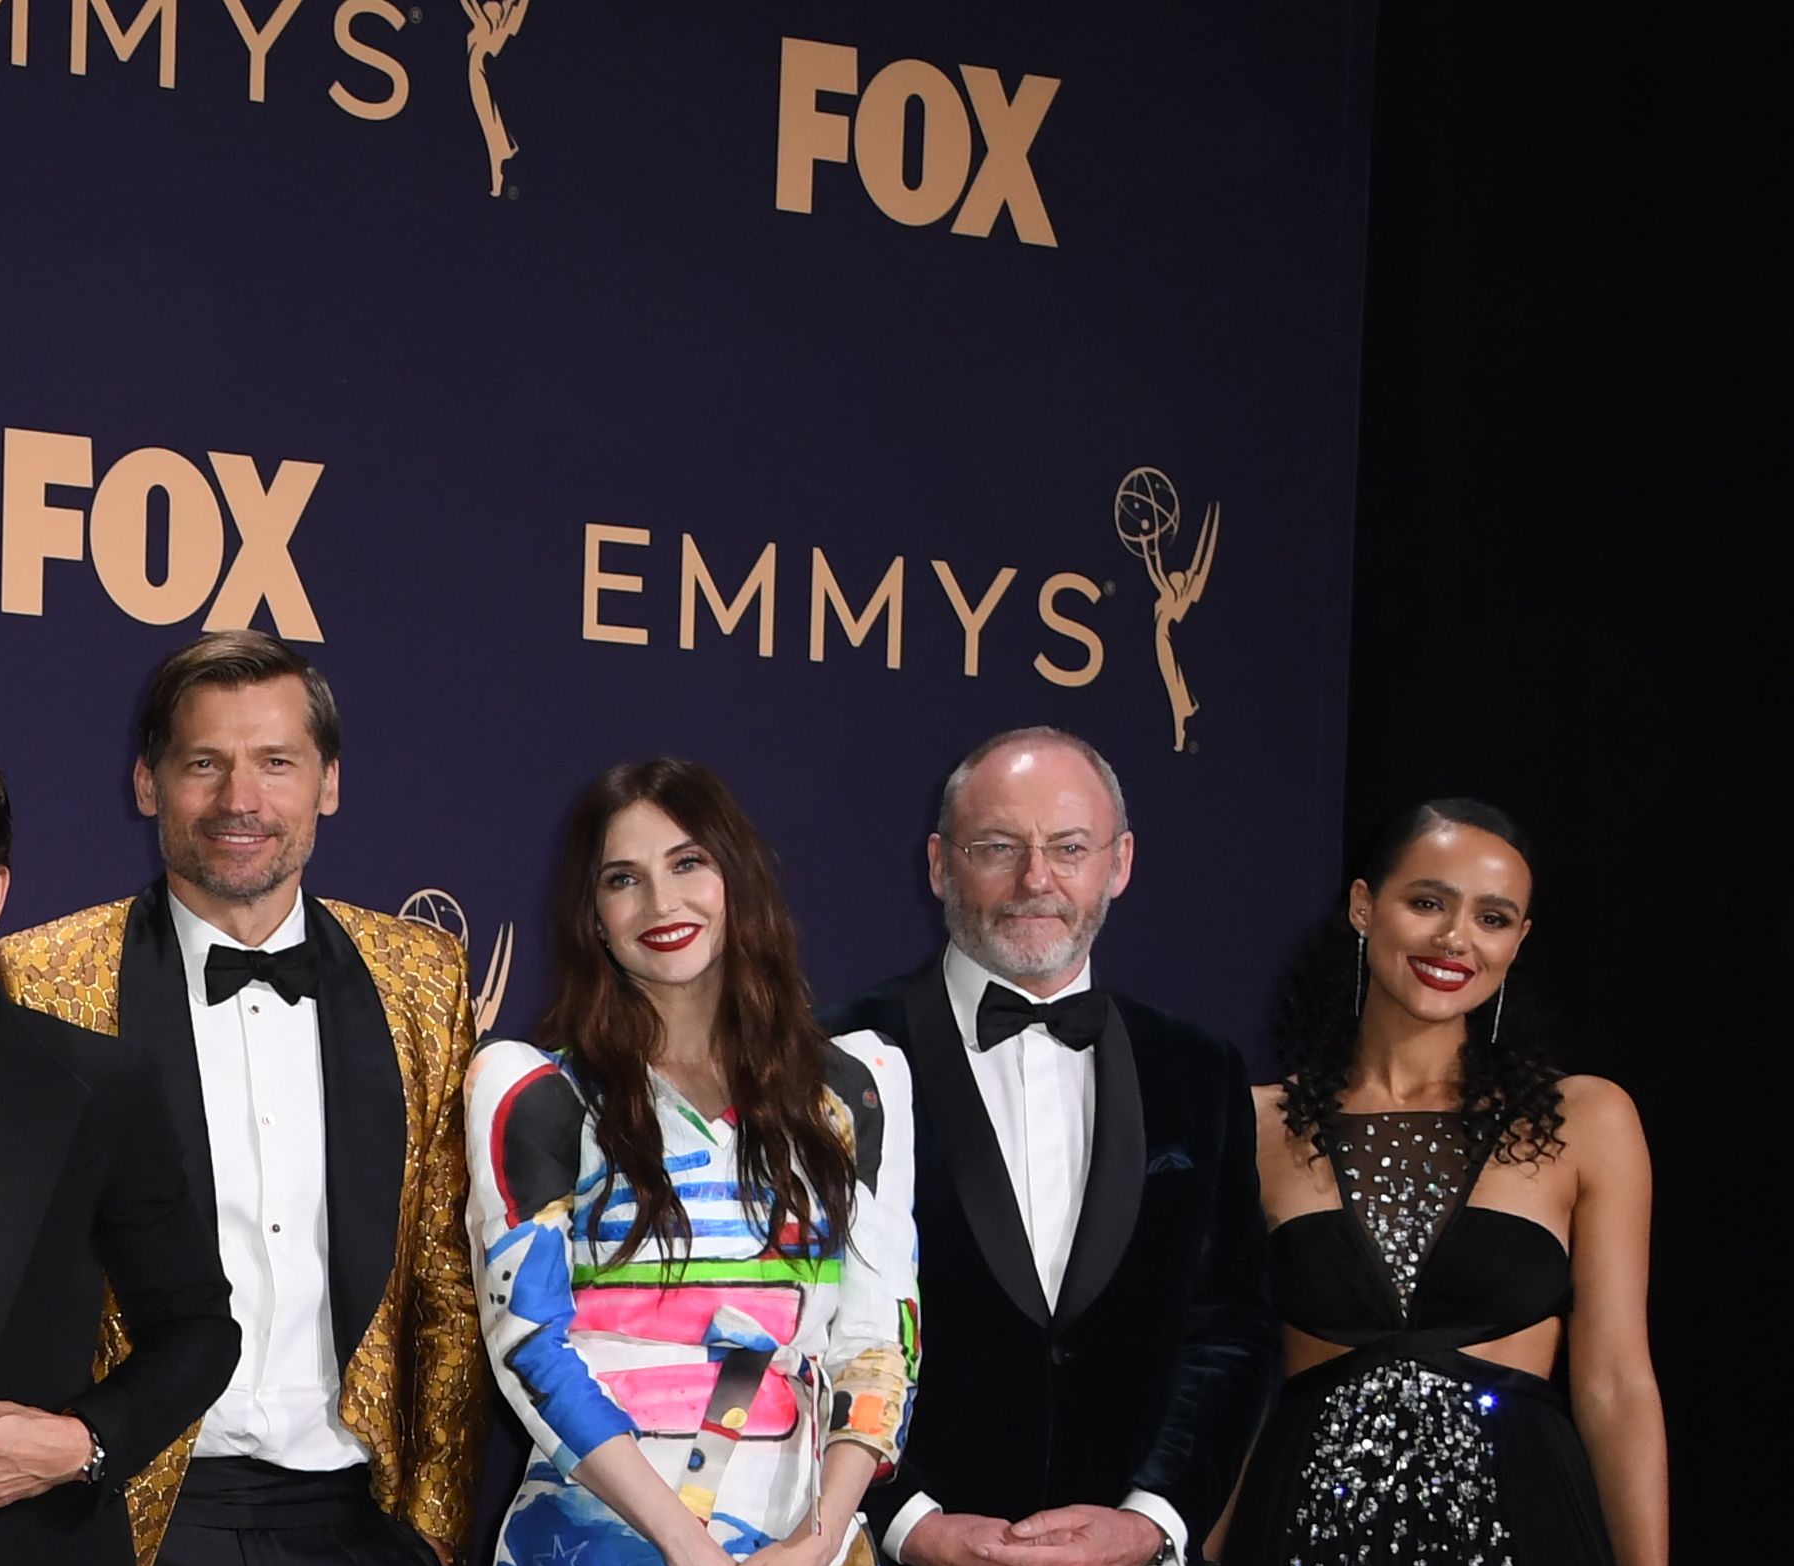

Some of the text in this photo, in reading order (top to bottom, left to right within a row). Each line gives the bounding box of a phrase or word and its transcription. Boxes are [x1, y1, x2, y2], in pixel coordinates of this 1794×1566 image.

[777, 37, 1061, 247] FOX
[1, 427, 324, 643] FOX
[583, 523, 1104, 687] EMMYS
